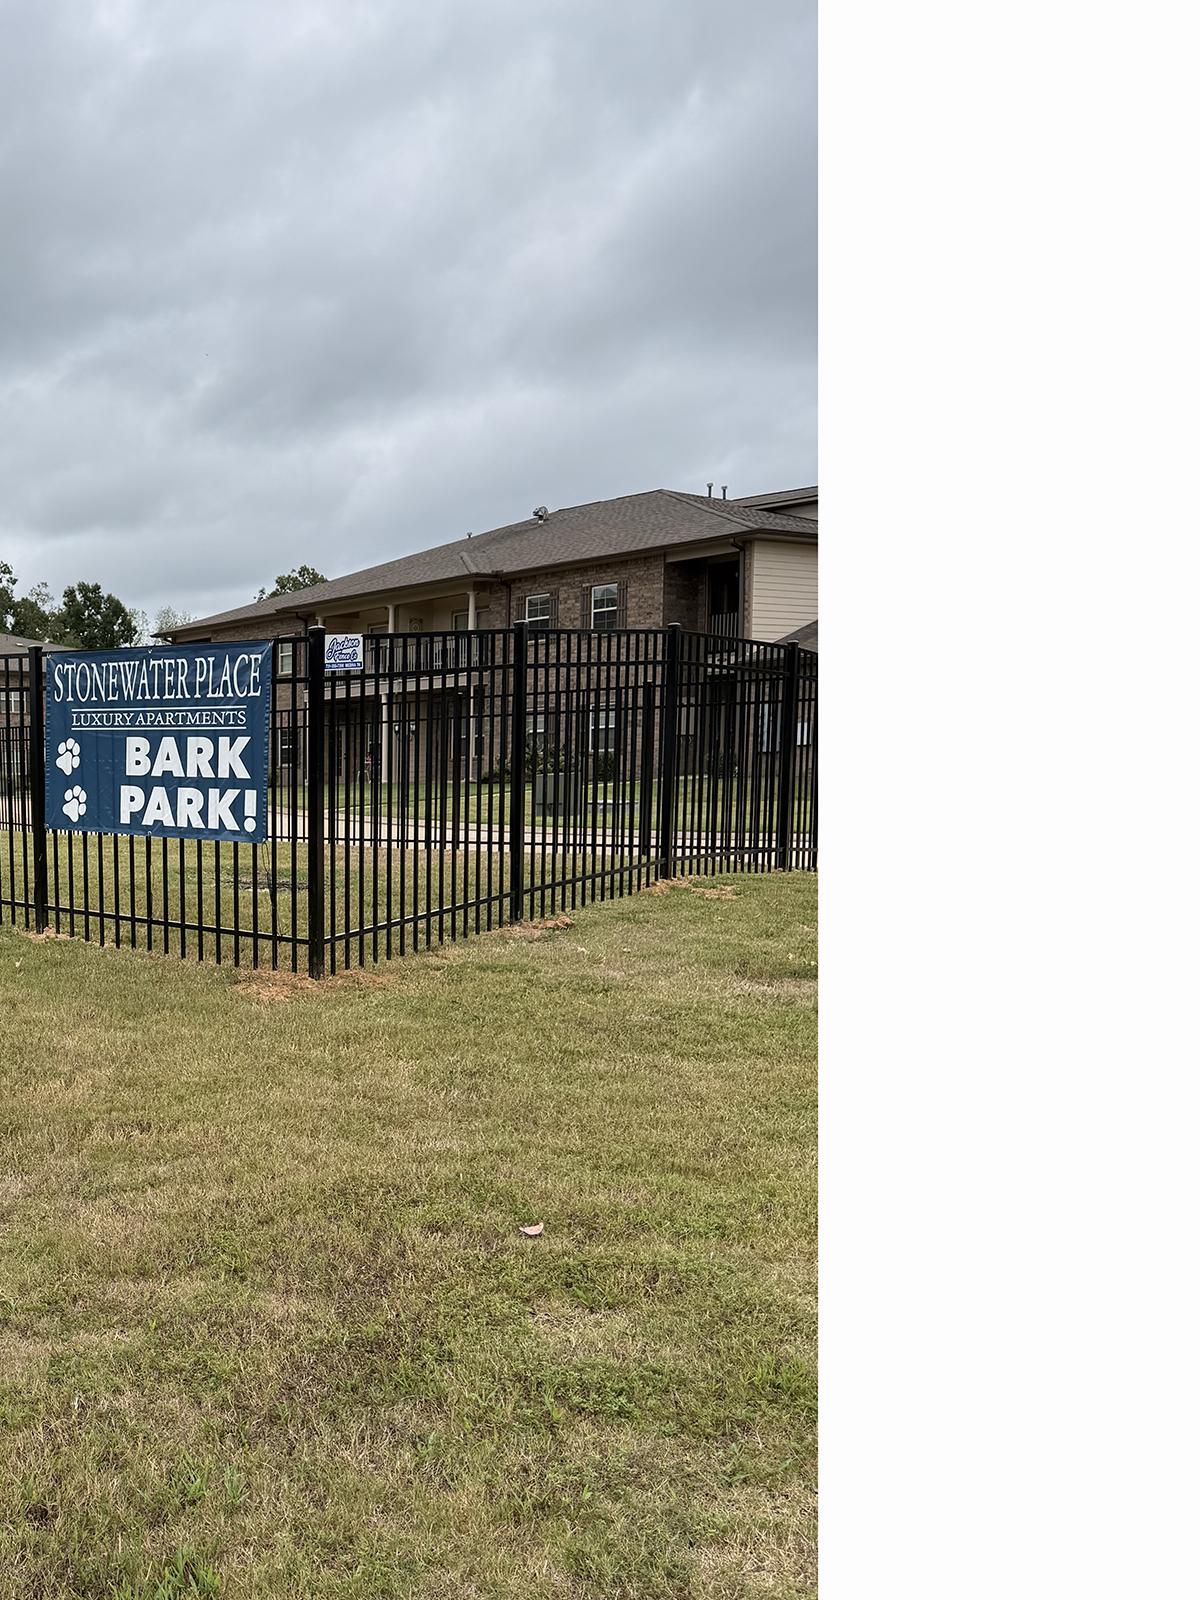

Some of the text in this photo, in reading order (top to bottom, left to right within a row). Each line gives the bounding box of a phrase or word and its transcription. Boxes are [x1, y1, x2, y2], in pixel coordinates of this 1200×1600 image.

[326, 636, 360, 660] Jackson
[334, 649, 350, 662] Fence
[54, 653, 262, 703] STONEWATER PLACE
[71, 710, 246, 726] LUXURY APARTMENTS
[125, 736, 251, 779] BARK
[119, 785, 257, 833] PARK!
